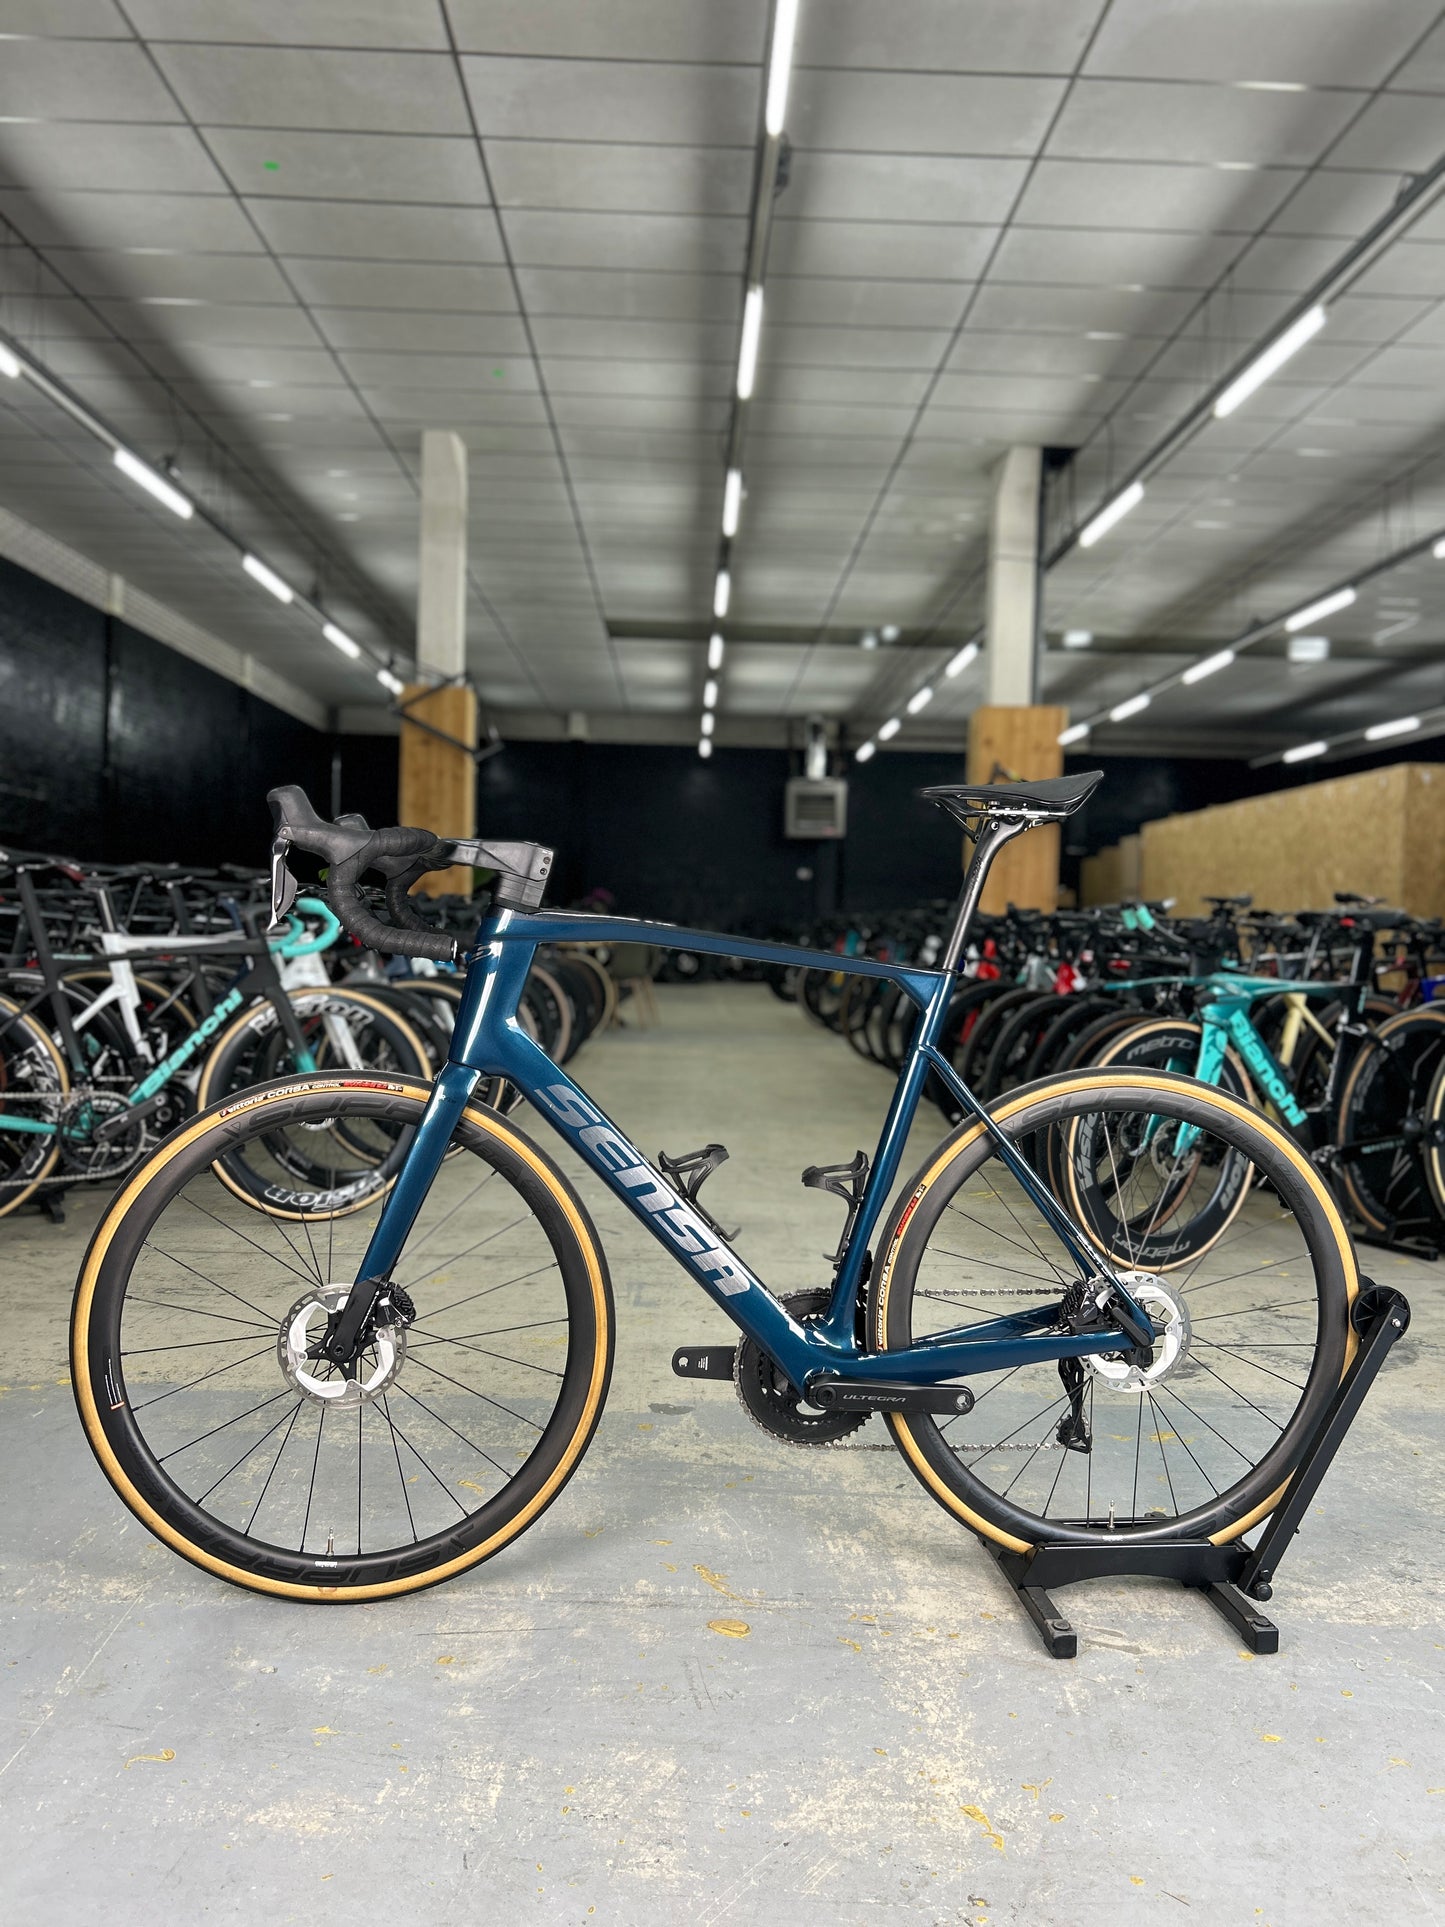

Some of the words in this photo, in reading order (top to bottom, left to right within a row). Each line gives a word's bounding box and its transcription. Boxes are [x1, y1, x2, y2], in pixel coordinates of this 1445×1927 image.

[141, 986, 244, 1100] Bianchi
[1126, 1034, 1197, 1061] metro
[1229, 1008, 1309, 1128] Bianchi
[267, 1084, 310, 1099] CORSA
[879, 1265, 891, 1306] CORSA
[842, 1392, 908, 1403] ULTEGRA
